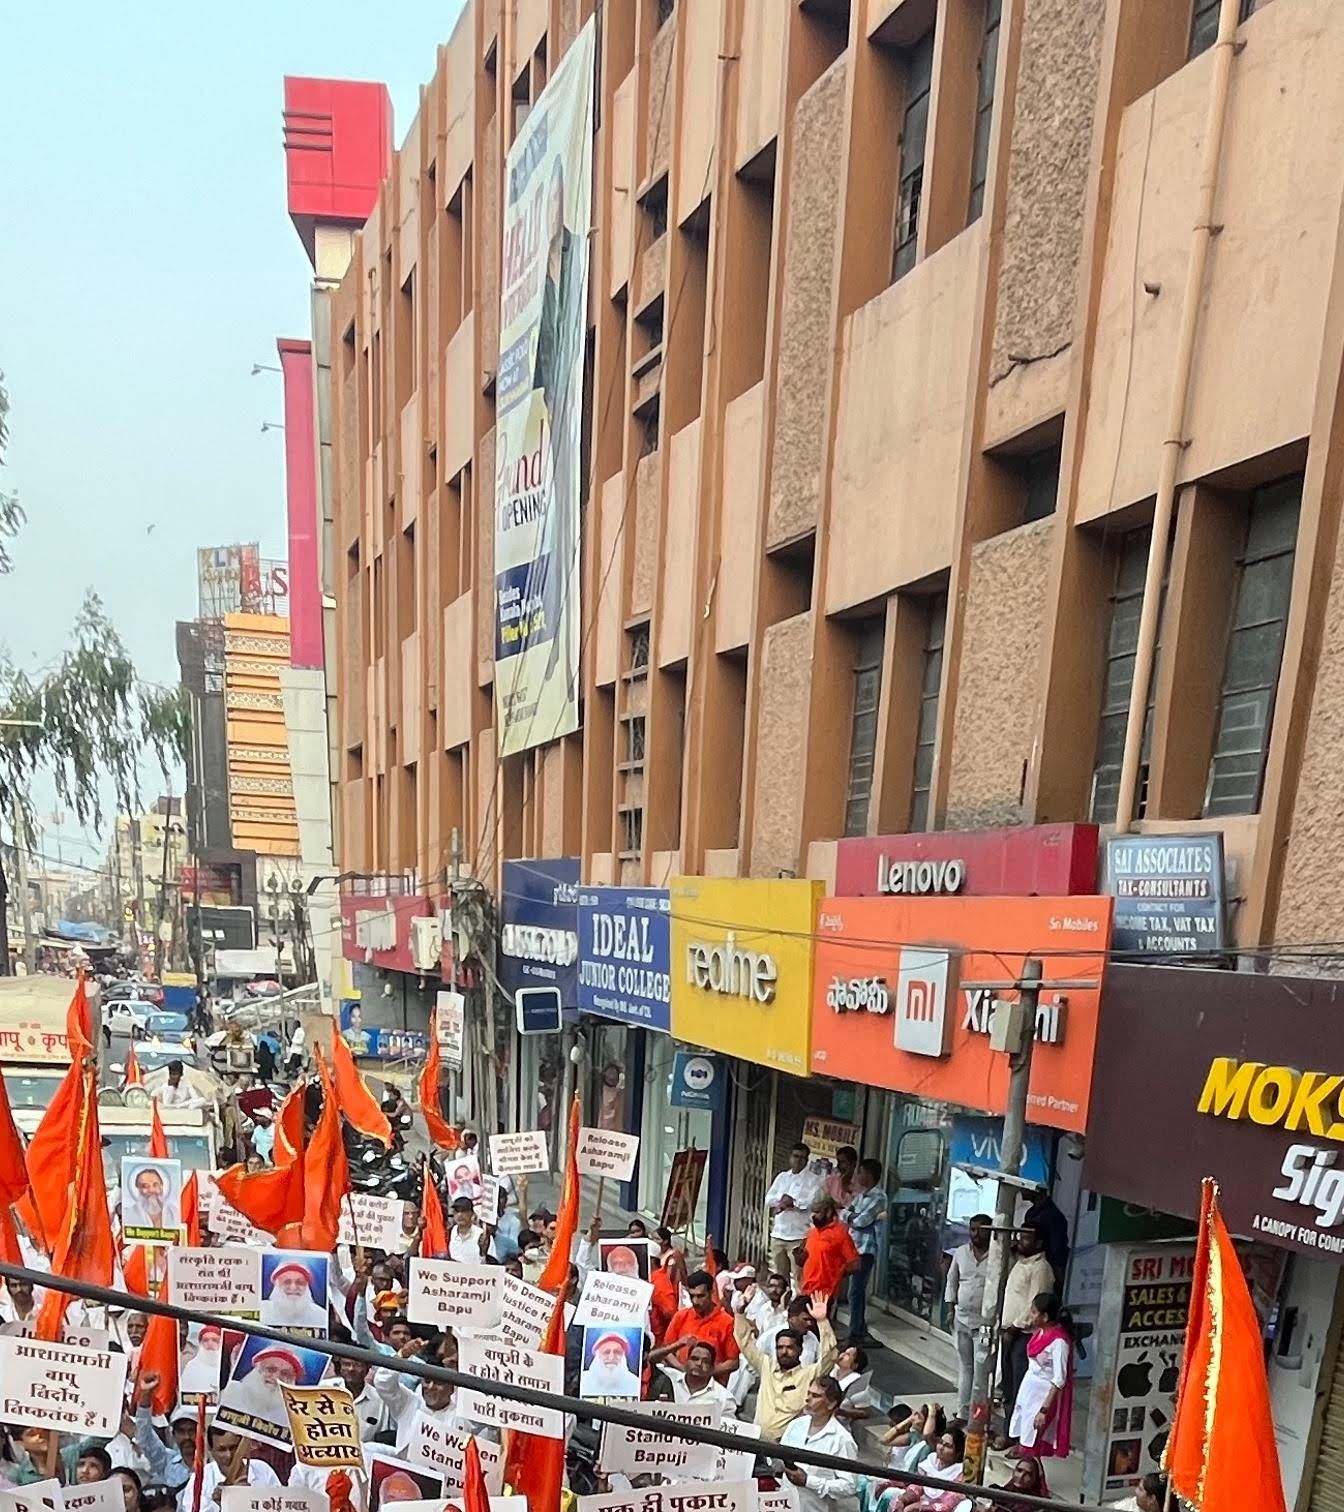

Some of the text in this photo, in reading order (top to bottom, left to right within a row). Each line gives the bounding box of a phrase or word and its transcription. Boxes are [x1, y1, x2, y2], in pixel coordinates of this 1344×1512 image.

[1115, 847, 1211, 873] SAI ASSOCIATES
[877, 854, 965, 894] Lenovo
[1062, 917, 1099, 932] Mobiles
[1173, 917, 1191, 931] VAT
[1194, 917, 1215, 932] TAX
[592, 914, 654, 963] IDEAL
[1147, 936, 1197, 951] ACCOUNTS
[686, 929, 777, 1002] realme
[580, 961, 616, 991] JUNIOR
[618, 966, 670, 1003] COLLEGE
[581, 1146, 630, 1163] Asharamji
[589, 1158, 614, 1170] Bapu
[1132, 1257, 1162, 1280] SRI
[417, 1270, 497, 1289] We Support
[592, 1277, 638, 1297] Release
[422, 1285, 491, 1302] Asharamji
[1129, 1287, 1173, 1305] SALES
[437, 1302, 473, 1315] Bapu
[584, 1293, 641, 1313] Asharamji
[590, 1308, 620, 1323] Bapu
[634, 1449, 688, 1466] Bapuji
